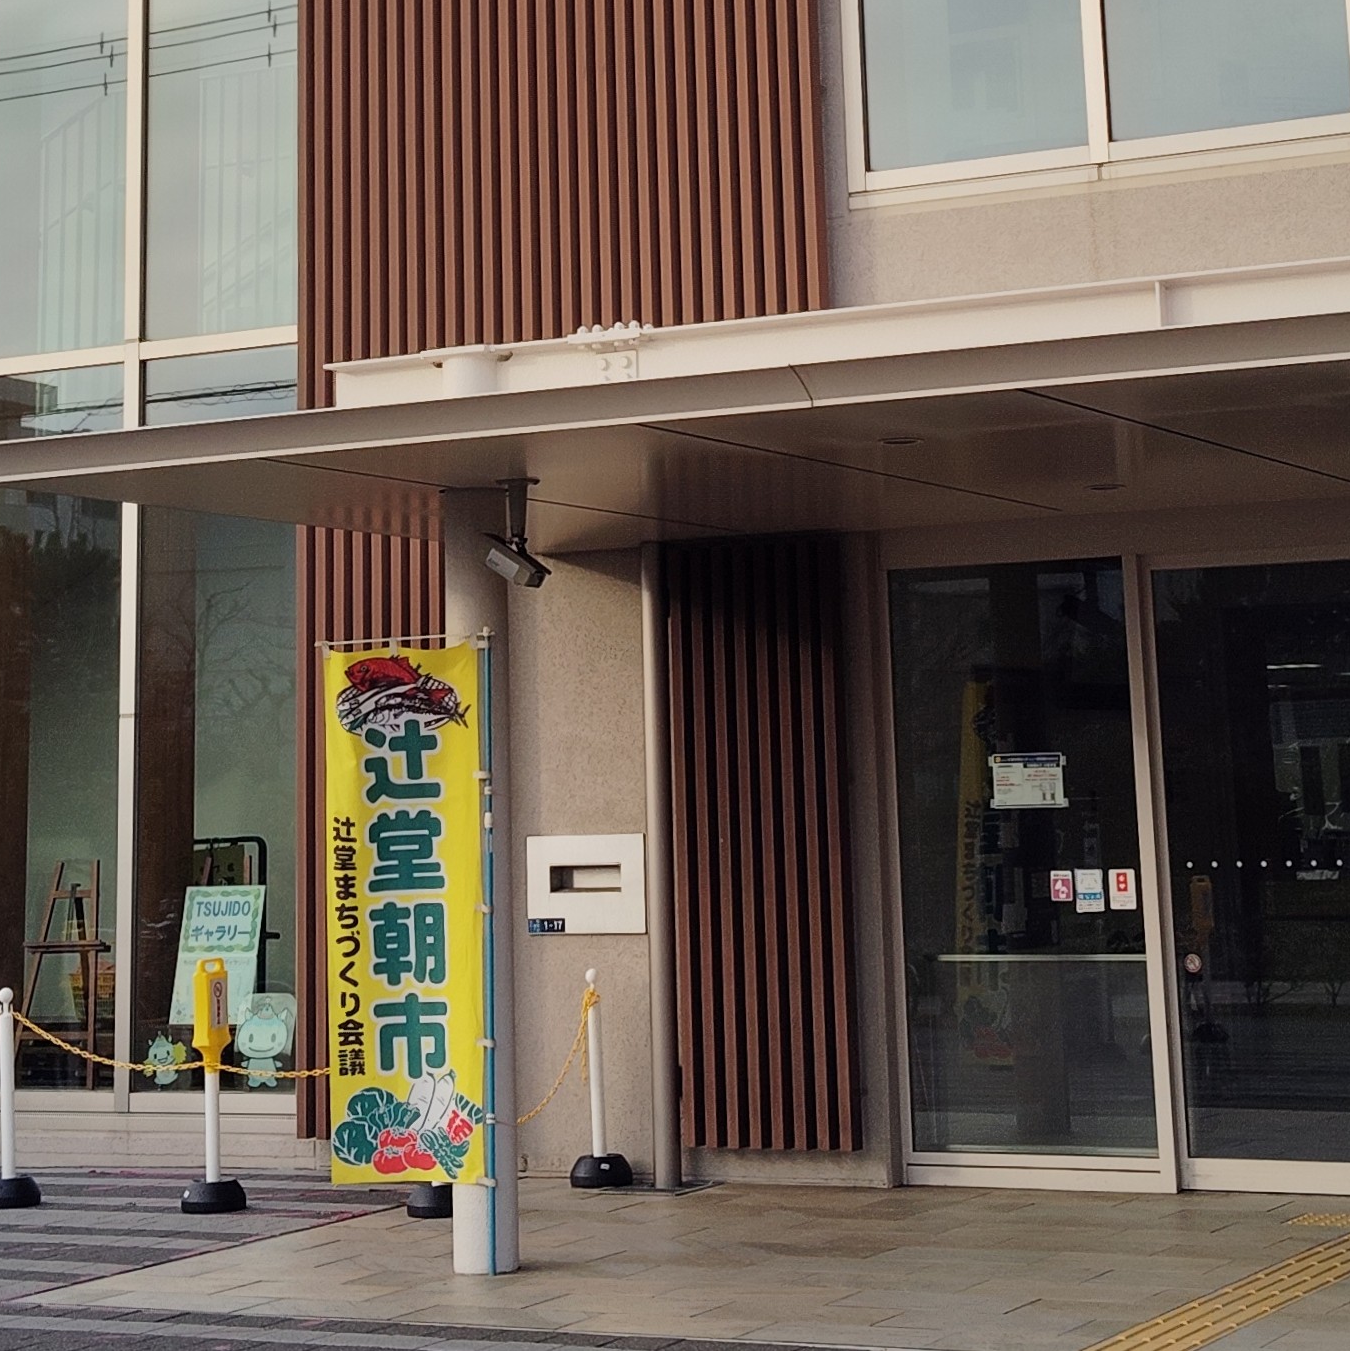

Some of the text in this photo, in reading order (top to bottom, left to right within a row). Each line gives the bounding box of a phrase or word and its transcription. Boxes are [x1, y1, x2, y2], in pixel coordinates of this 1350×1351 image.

[190, 925, 250, 943] ギャラリー
[196, 900, 251, 918] TSUJIDO
[333, 816, 365, 1076] 辻堂まちづくり会議
[364, 719, 448, 1079] 辻堂朝市
